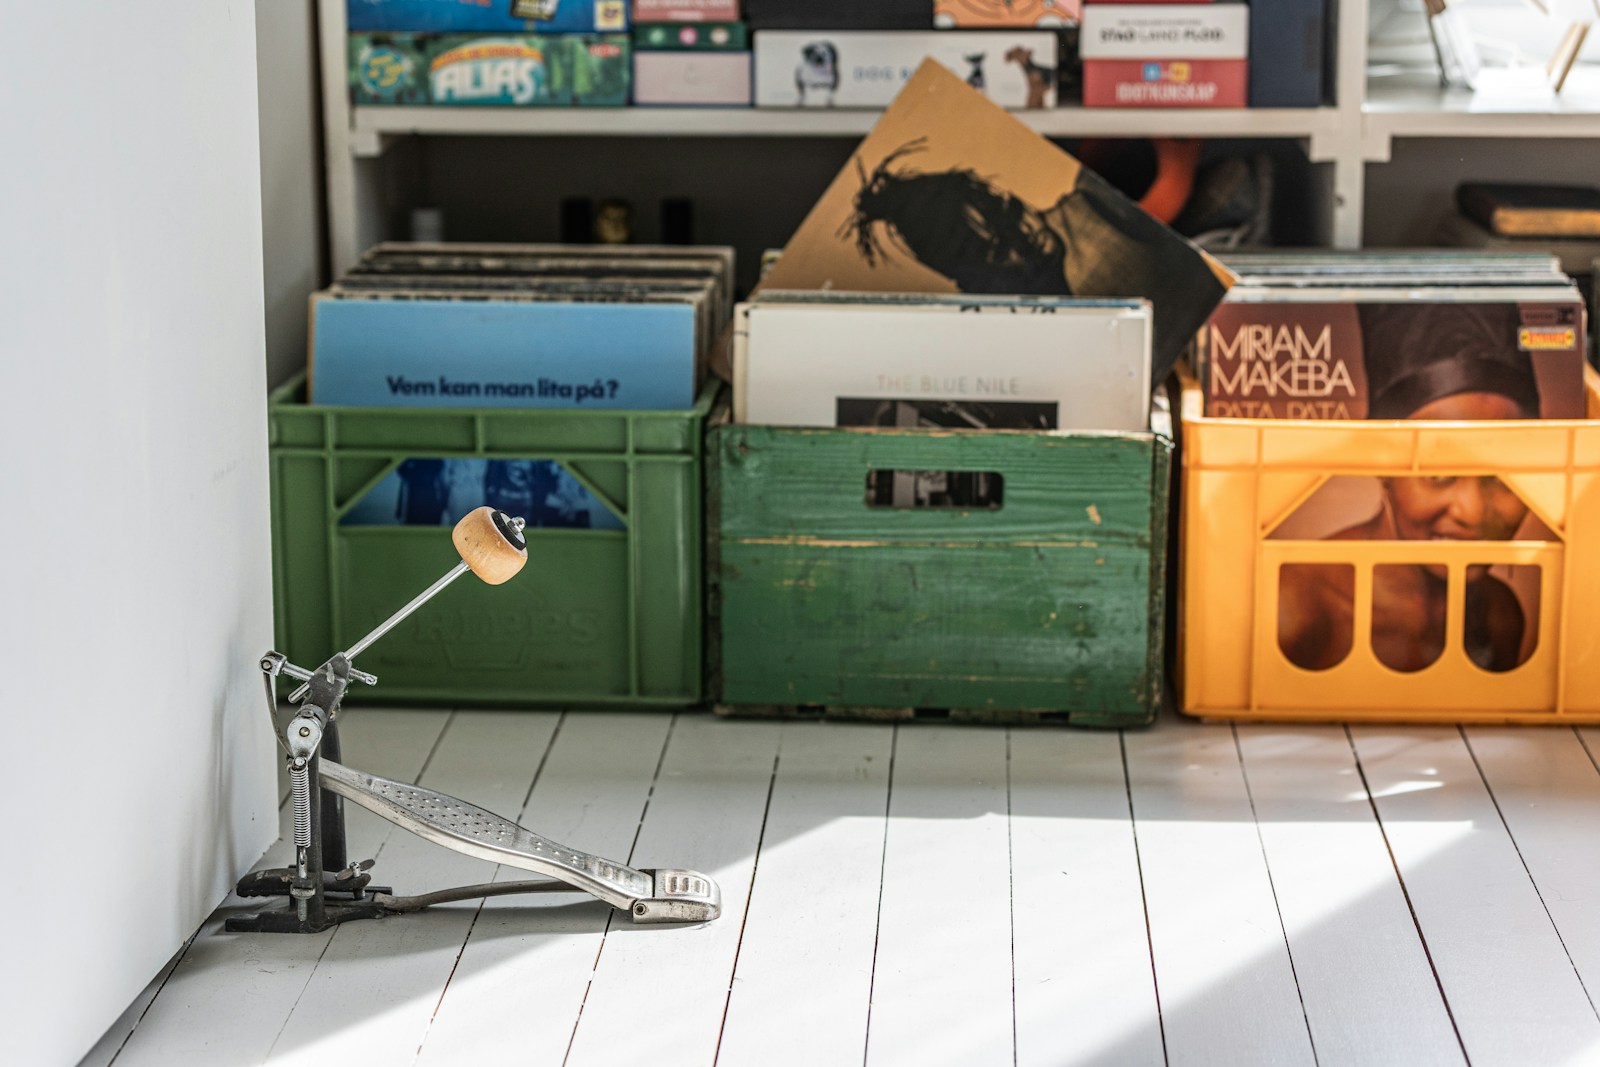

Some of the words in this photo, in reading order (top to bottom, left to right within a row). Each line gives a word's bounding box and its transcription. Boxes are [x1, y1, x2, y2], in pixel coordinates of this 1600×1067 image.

[437, 60, 535, 103] ALIAS
[853, 66, 894, 80] DOG
[1210, 324, 1332, 361] MIRIAM
[387, 376, 435, 396] Vem
[439, 377, 481, 396] kan
[485, 380, 534, 397] man
[538, 379, 571, 398] lita
[877, 374, 911, 392] THE
[920, 375, 969, 393] BLUE
[976, 376, 1020, 395] NILE
[1211, 359, 1356, 398] MAKEBA
